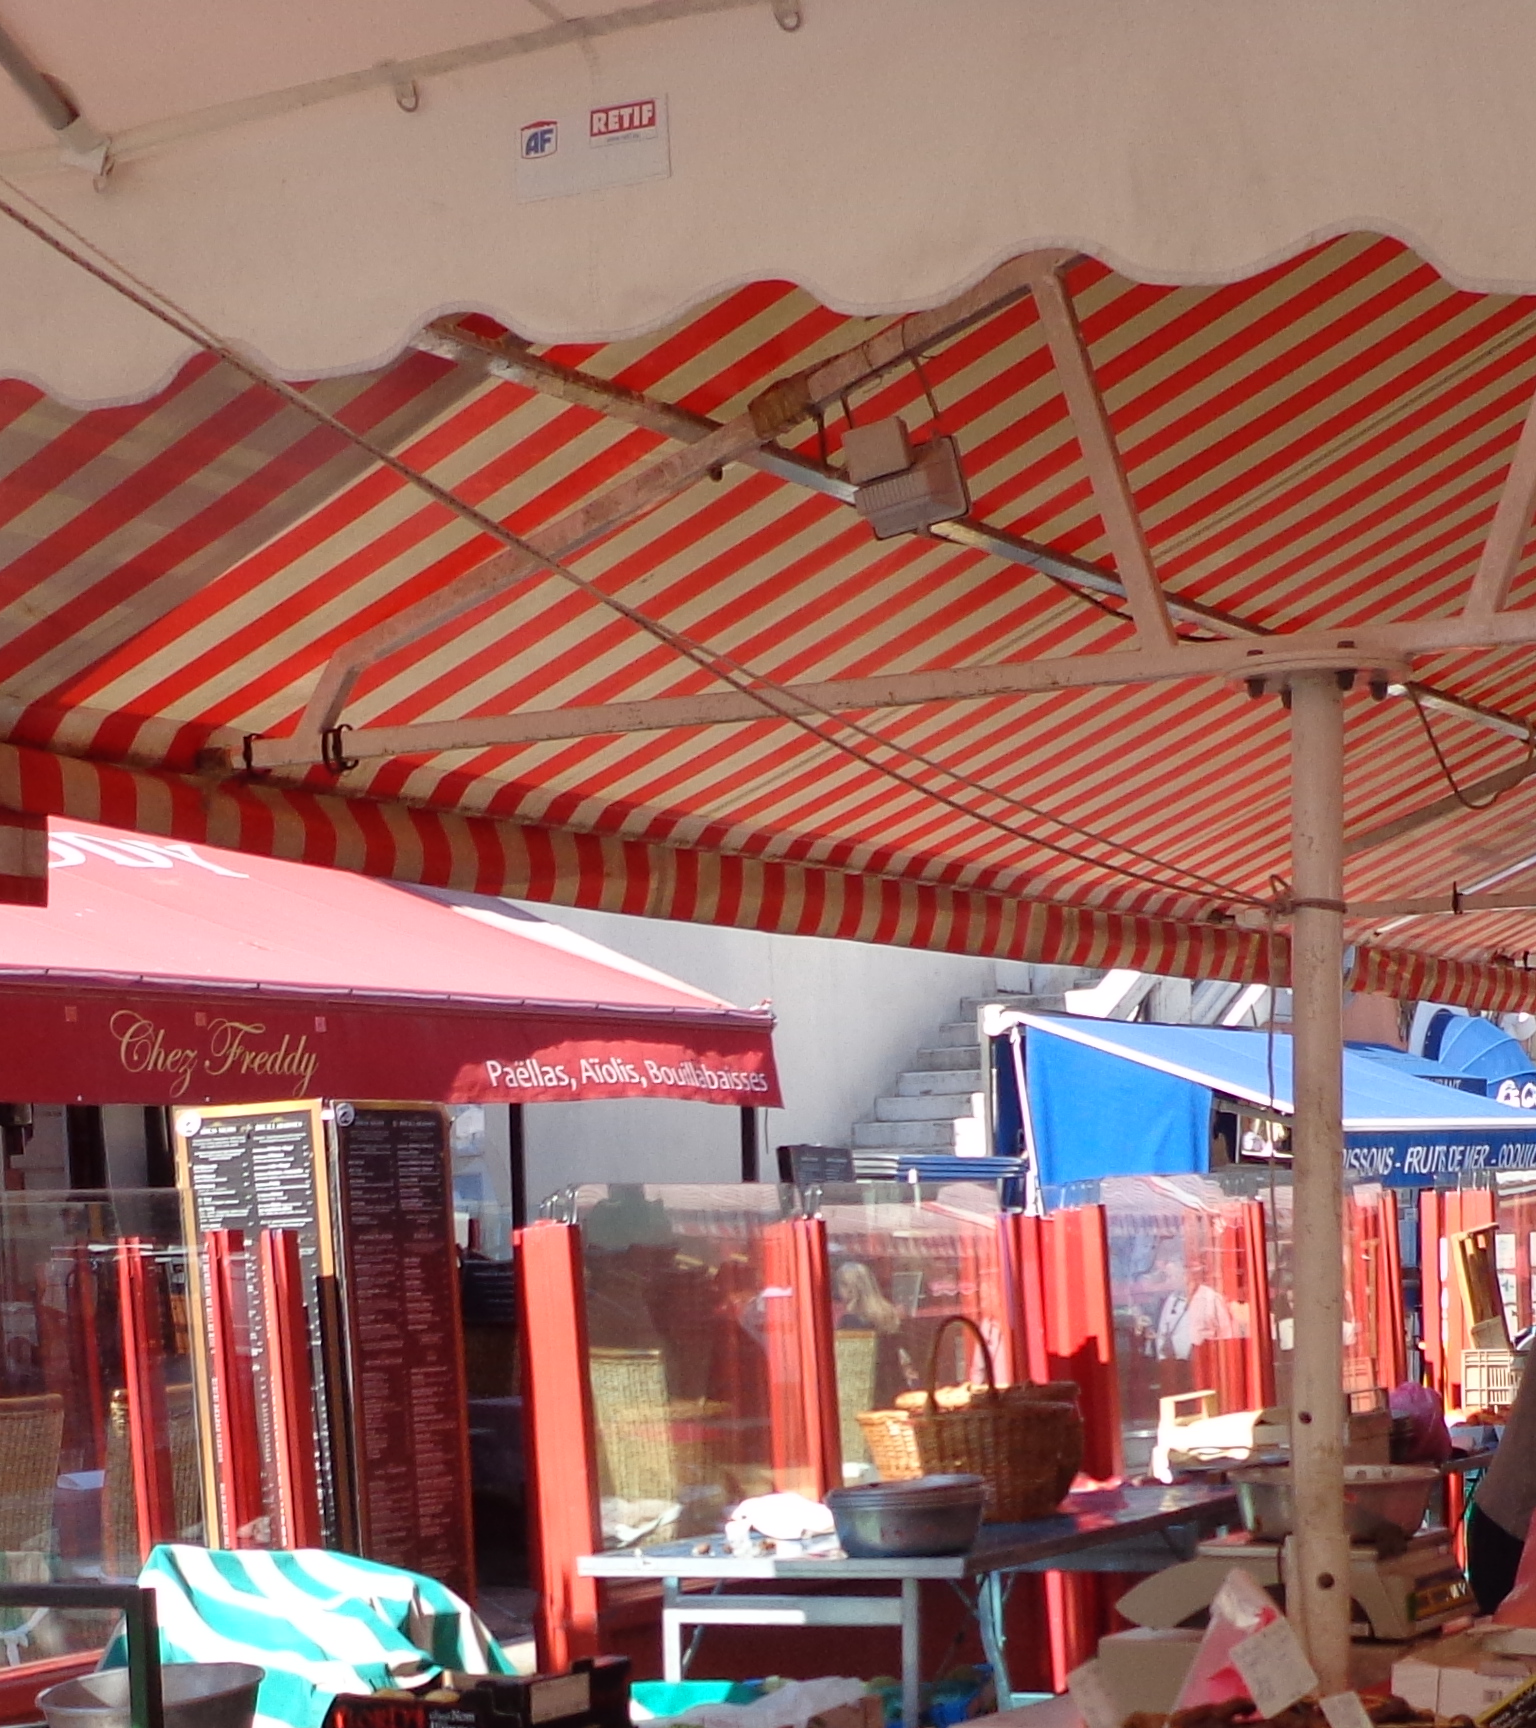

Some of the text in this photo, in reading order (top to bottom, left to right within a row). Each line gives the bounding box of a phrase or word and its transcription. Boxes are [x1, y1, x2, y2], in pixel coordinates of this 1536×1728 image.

[591, 104, 654, 134] RETIF
[525, 128, 553, 155] AF
[109, 1010, 319, 1098] Chez Freddy
[487, 1056, 767, 1093] Paëllas, Aïolis, Bouillabaisses
